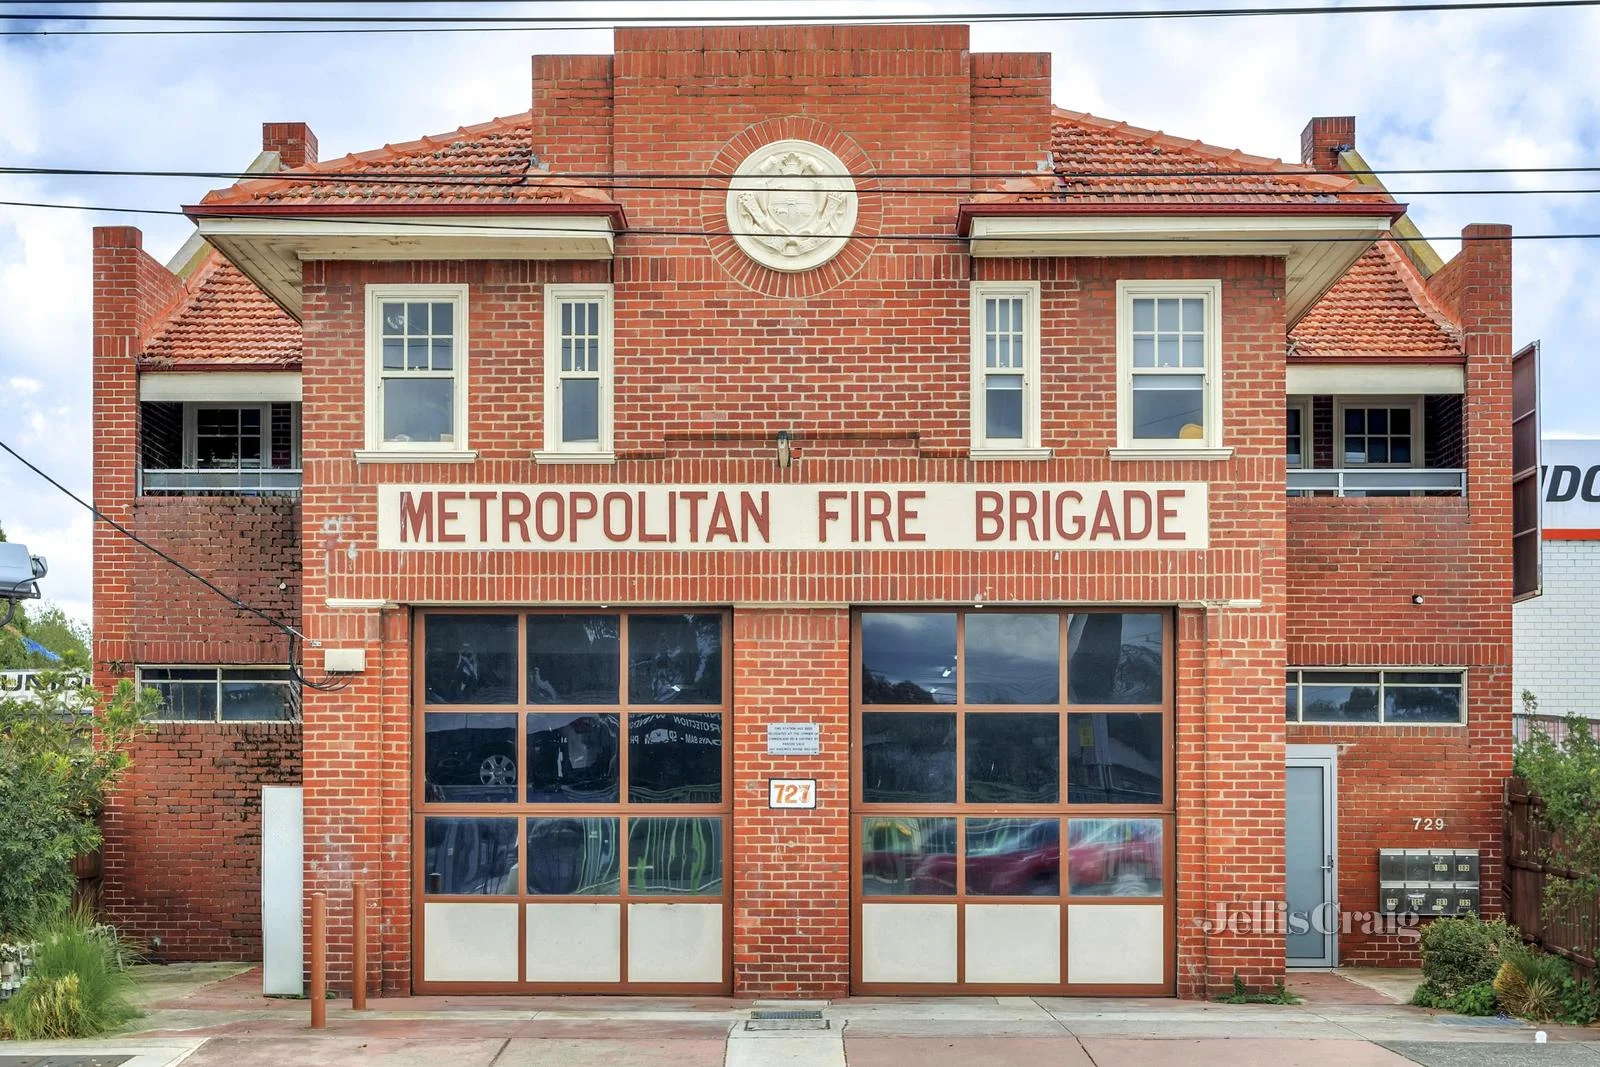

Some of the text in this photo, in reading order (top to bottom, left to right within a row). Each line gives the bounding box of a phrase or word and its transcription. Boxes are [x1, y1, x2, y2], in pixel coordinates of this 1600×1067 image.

[400, 489, 1186, 543] METROPOLITAN FIRE BRIGADE
[773, 784, 811, 804] 727
[1412, 817, 1444, 831] 729
